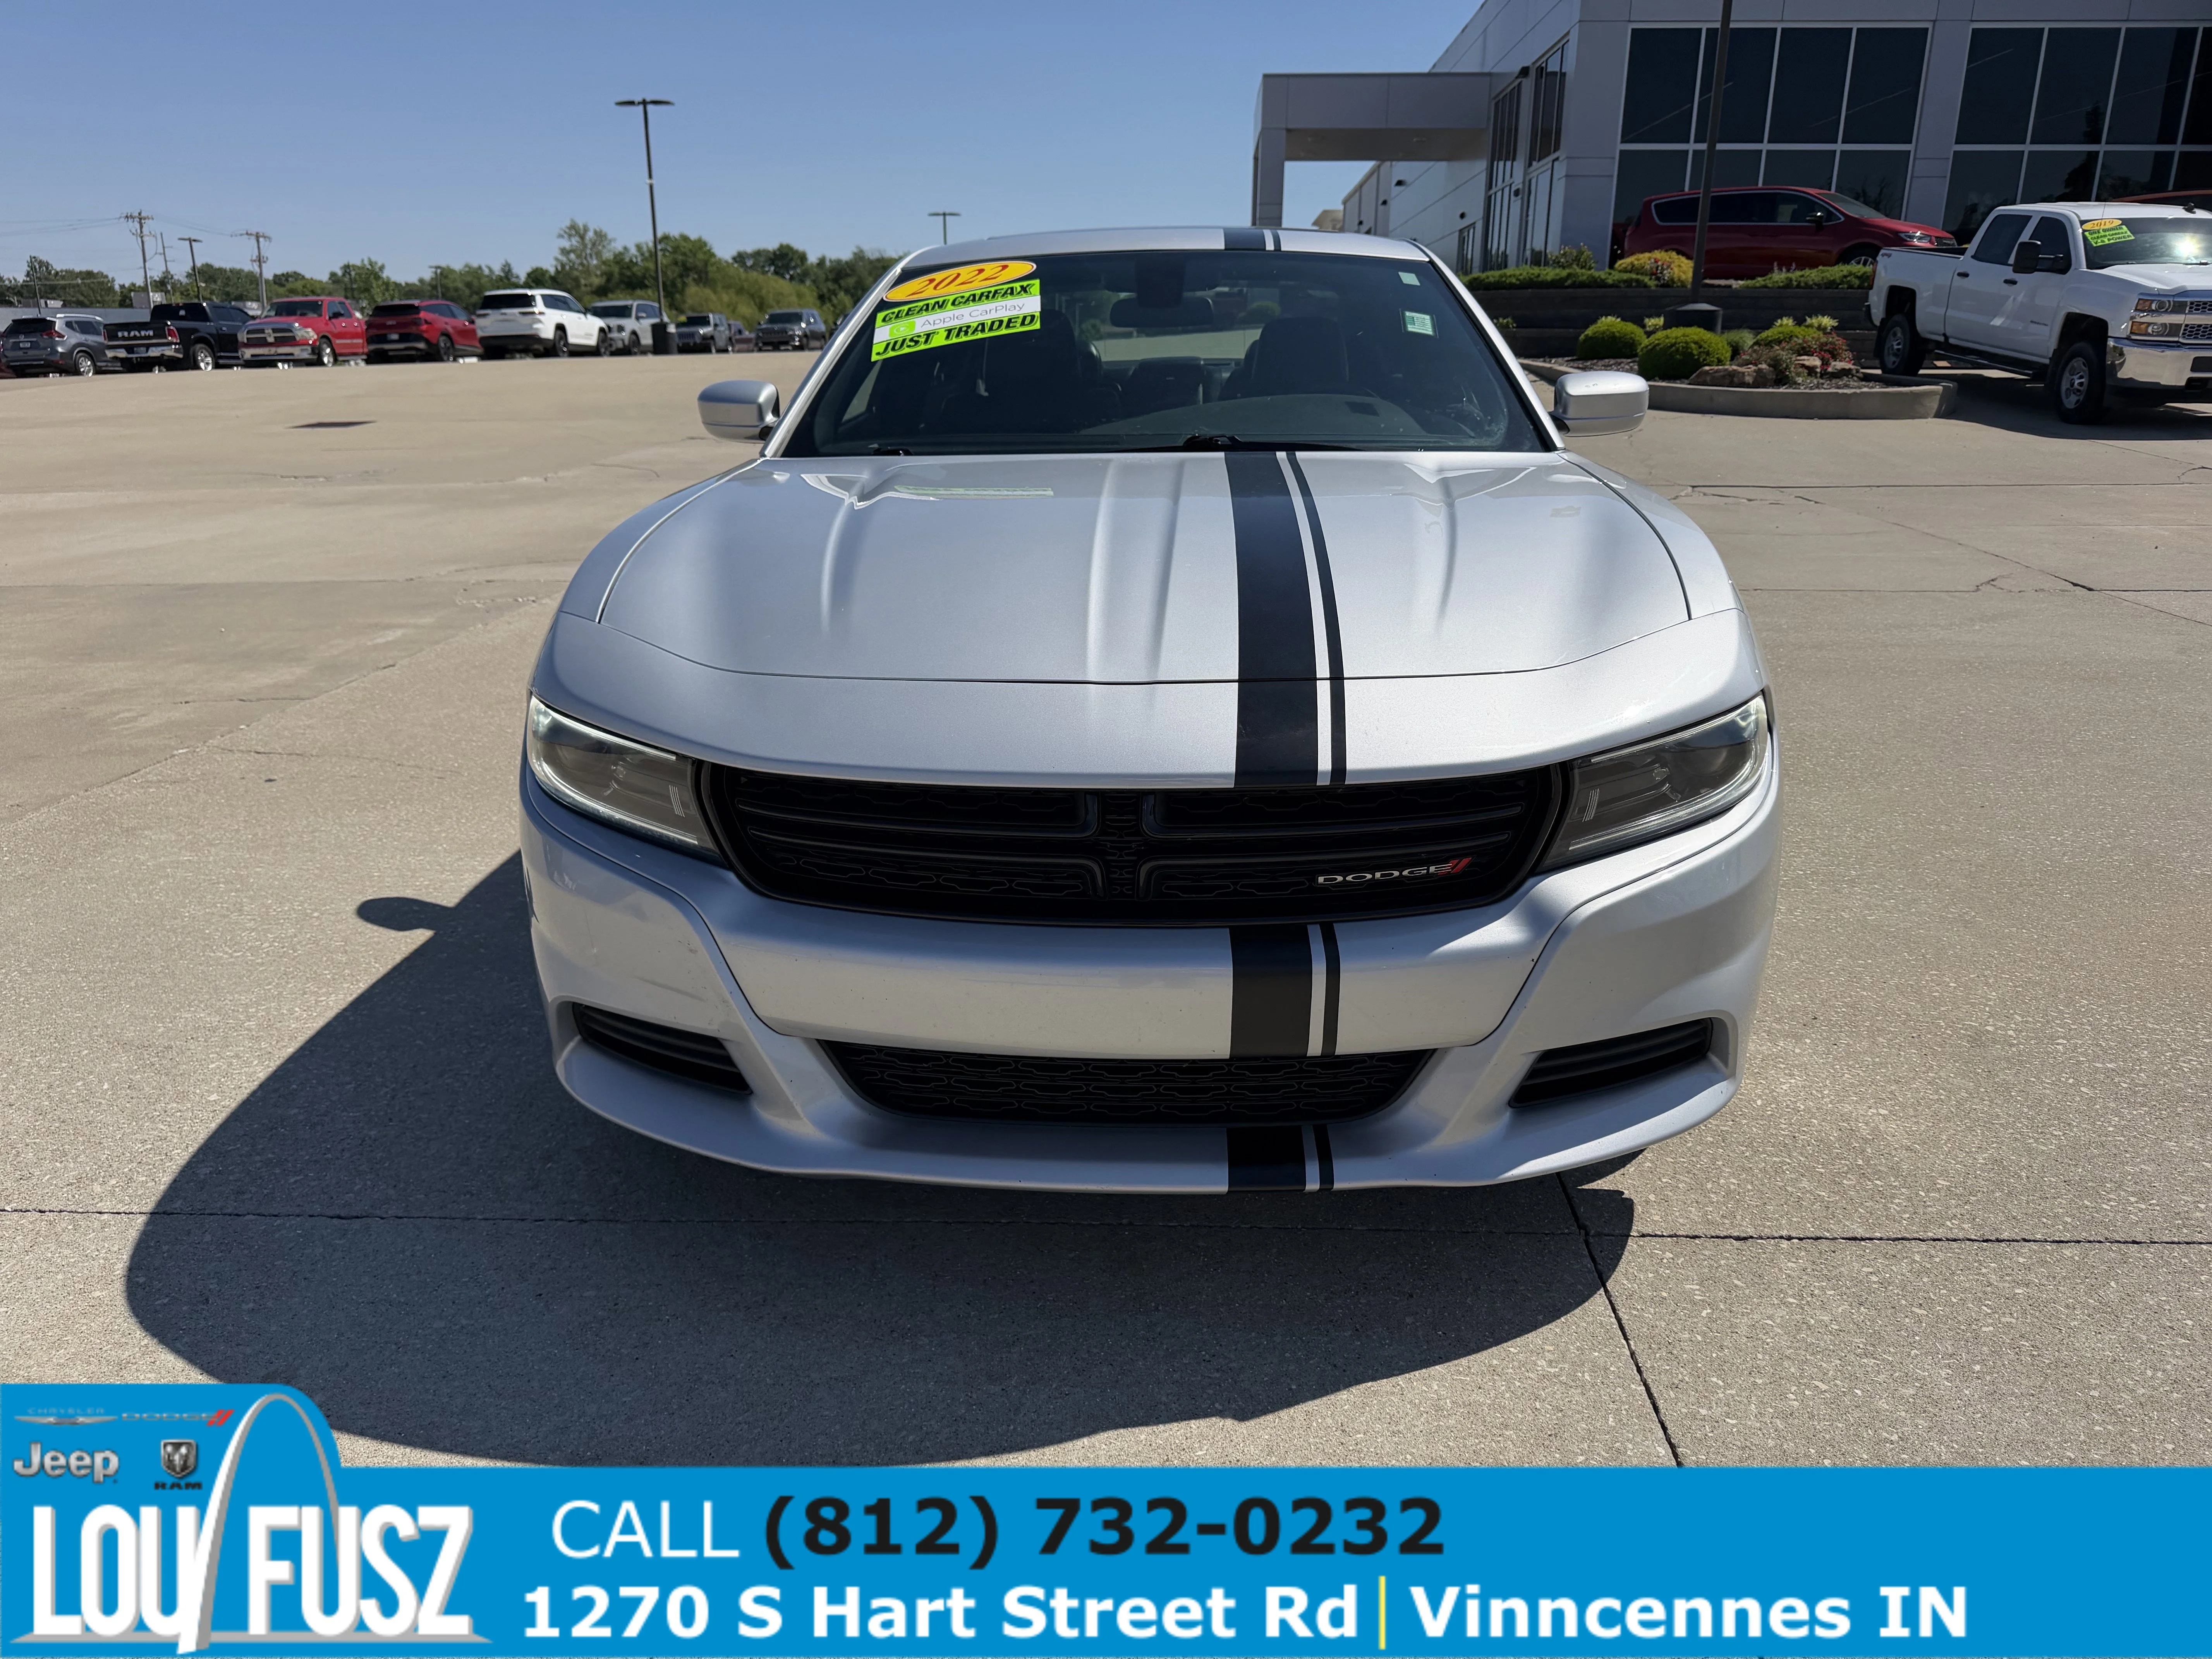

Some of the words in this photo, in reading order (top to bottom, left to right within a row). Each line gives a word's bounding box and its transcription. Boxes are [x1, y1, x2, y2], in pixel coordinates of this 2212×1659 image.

[2090, 220, 2114, 228] 2019
[905, 265, 1009, 297] 2022
[881, 298, 950, 323] CLEAN
[951, 283, 1036, 308] CARFAX
[921, 313, 965, 328] Apple
[969, 303, 1025, 318] CarPlay
[875, 331, 939, 356] JUST
[944, 314, 1039, 342] TRADED
[1318, 863, 1453, 884] DODGE
